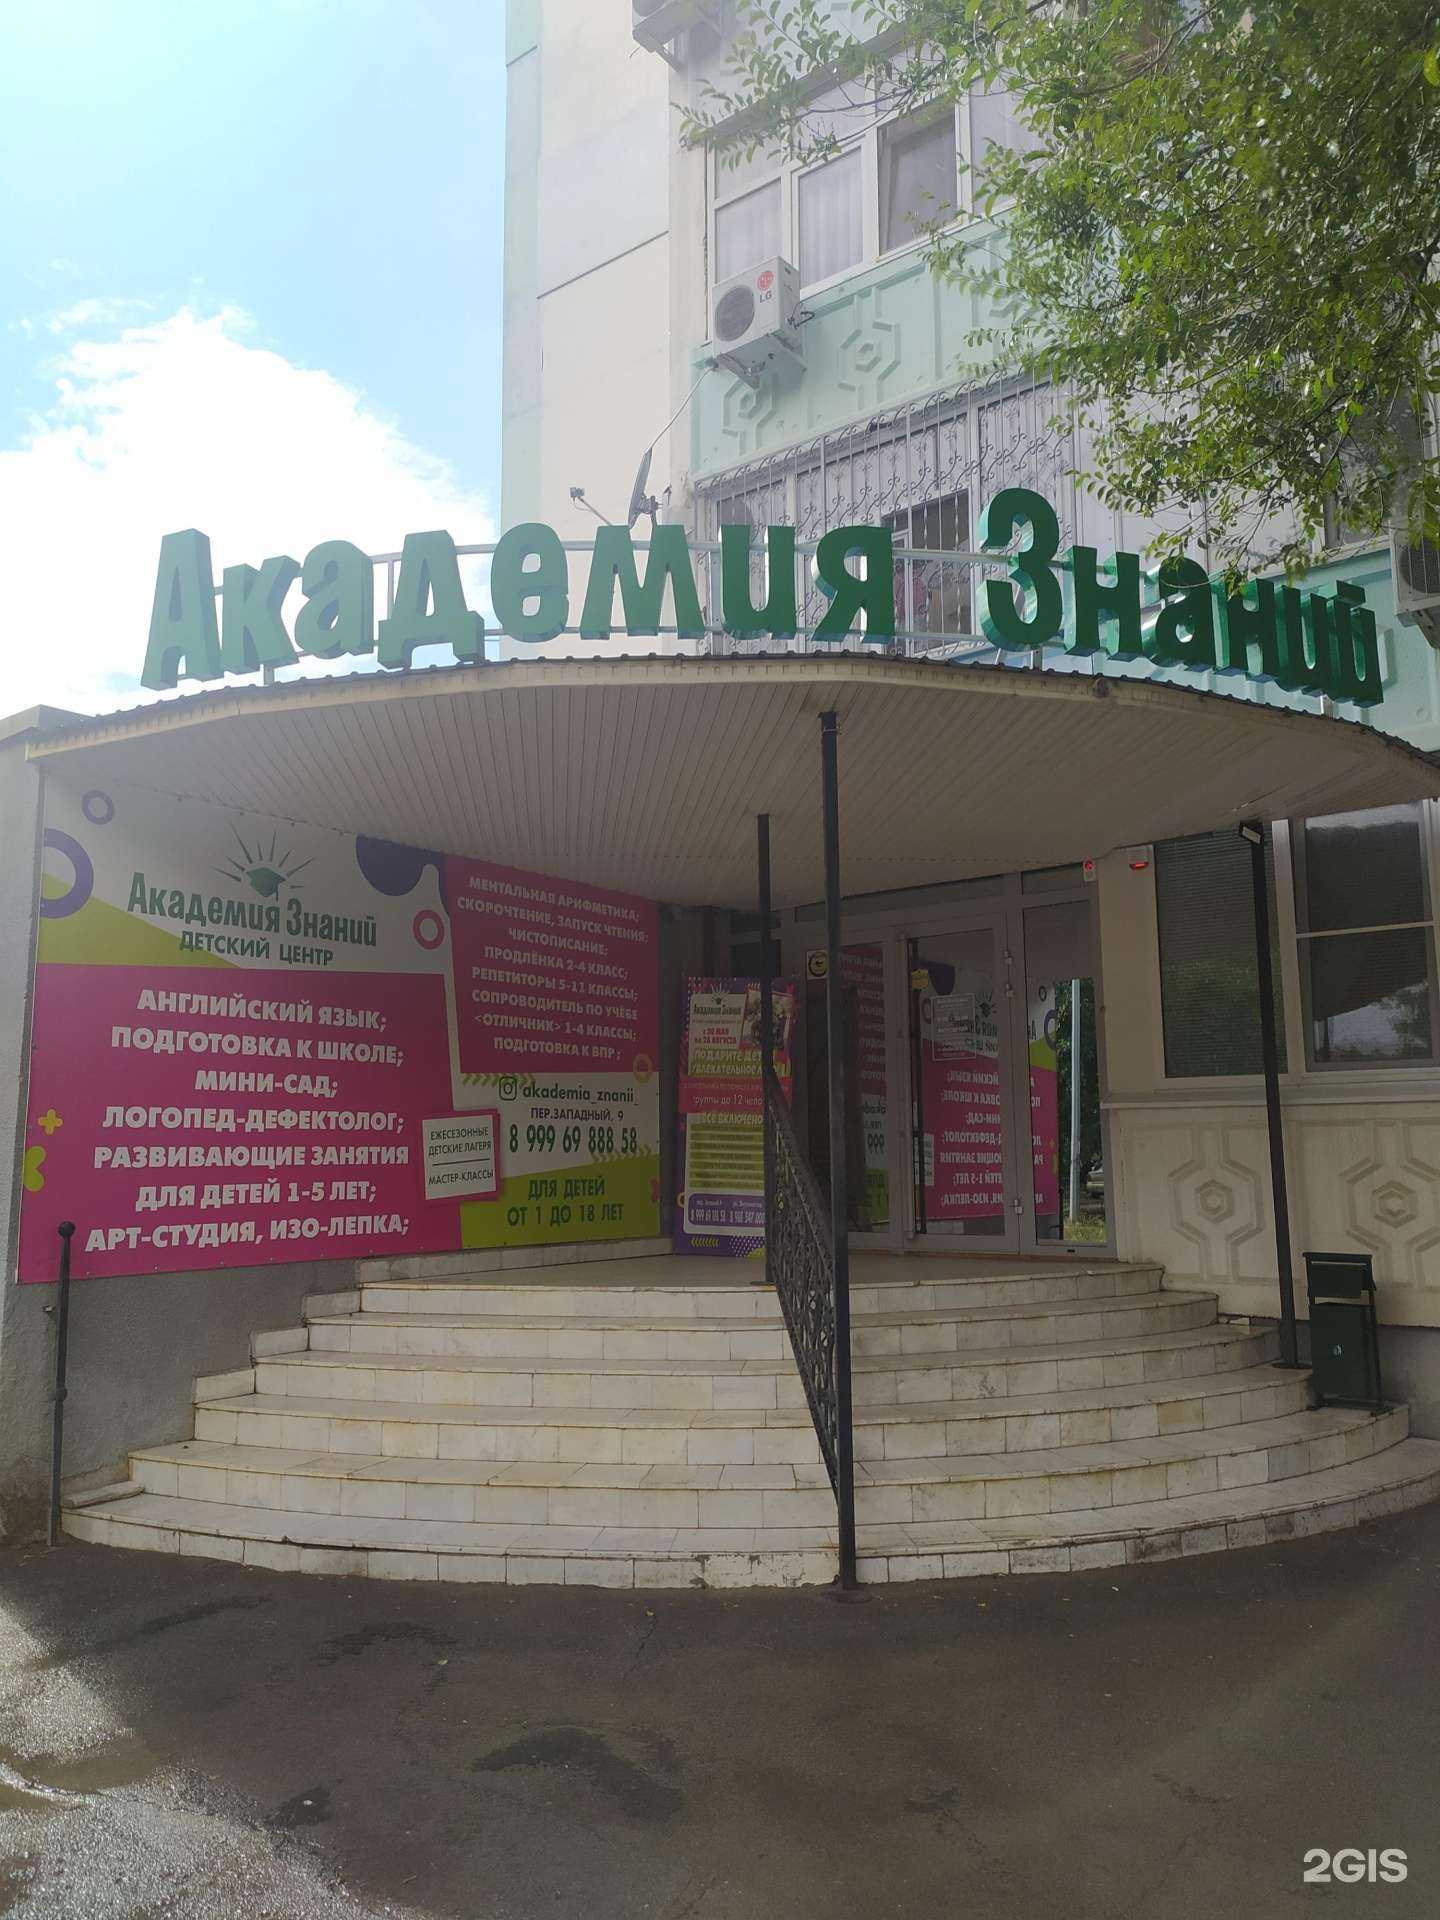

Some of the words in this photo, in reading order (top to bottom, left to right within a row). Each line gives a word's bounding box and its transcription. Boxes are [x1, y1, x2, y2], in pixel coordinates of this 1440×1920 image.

[760, 290, 772, 303] LG
[141, 522, 894, 690] Академия
[979, 487, 1384, 708] Знаний
[126, 871, 280, 933] Академия
[286, 897, 377, 947] Знаний
[469, 876, 555, 903] МЕНТАЛЬНАЯ
[558, 895, 640, 922] АРИФМЕТИКА;
[457, 896, 555, 927] СКОРОЧТЕНИЕ,
[557, 915, 602, 935] ЗАПУСК
[604, 924, 649, 944] ЧТЕНИЯ;
[179, 930, 269, 960] ДЕТСКИЙ
[279, 944, 334, 966] ЦЕНТР
[509, 927, 609, 957] ЧИСТОПИСАНИЕ;
[472, 966, 556, 989] РЕПЕТИТОРЫ
[559, 979, 585, 992] 5-11
[588, 983, 638, 1001] КЛАССЫ;
[566, 960, 586, 971] 2-4
[588, 964, 628, 980] КЛАСС;
[137, 989, 313, 1025] АНГЛИЙСКИЙ
[317, 1006, 387, 1032] ЯЗЫК;
[472, 989, 583, 1014] СОПРОВОДИТЕЛЬ
[586, 1004, 603, 1016] ПО
[566, 1022, 584, 1035] 1-4
[586, 1024, 637, 1041] КЛАССЫ;
[111, 1026, 291, 1059] ПОДГОТОВКА
[296, 1040, 313, 1059] К
[317, 1041, 405, 1068] ШКОЛЕ;
[494, 1037, 579, 1056] ПОДГОТОВКА
[582, 1046, 589, 1057] К
[592, 1046, 621, 1060] ВПР;
[195, 1070, 338, 1098] МИНИ-САД;
[102, 1106, 405, 1134] ЛОГОПЕД-ДЕФЕКТОЛОГ;
[531, 1107, 614, 1122] ПЕР.ЗАПАДНЫЙ,
[618, 1111, 624, 1121] 9
[430, 1126, 489, 1141] ЕЖЕСЕЗОННЫЕ
[509, 1124, 519, 1153] 8
[526, 1124, 556, 1153] 999
[563, 1126, 581, 1153] 69
[588, 1126, 614, 1153] 888
[621, 1127, 638, 1153] 58
[94, 1146, 306, 1171] РАЗВИВАЮЩИЕ
[310, 1145, 409, 1165] ЗАНЯТИЯ
[428, 1143, 463, 1158] ДЕТСКИЕ
[464, 1140, 492, 1153] ЛАГЕРЯ
[428, 1169, 494, 1186] МАСТЕР-КЛАССЫ
[528, 1180, 557, 1200] ДЛЯ
[563, 1176, 606, 1198] ДЕТЕЙ
[135, 1185, 195, 1212] ДЛЯ
[201, 1177, 280, 1208] ДЕТЕЙ
[287, 1181, 324, 1203] 1-5
[329, 1181, 377, 1203] ЛЕТ;
[507, 1206, 528, 1227] ОТ
[535, 1206, 541, 1225] 1
[550, 1206, 572, 1227] ДО
[580, 1204, 595, 1222] 18
[600, 1203, 624, 1222] ЛЕТ
[85, 1221, 263, 1253] АРТ-СТУДИЯ,
[270, 1213, 409, 1241] ИЗО-ЛЕПКА;
